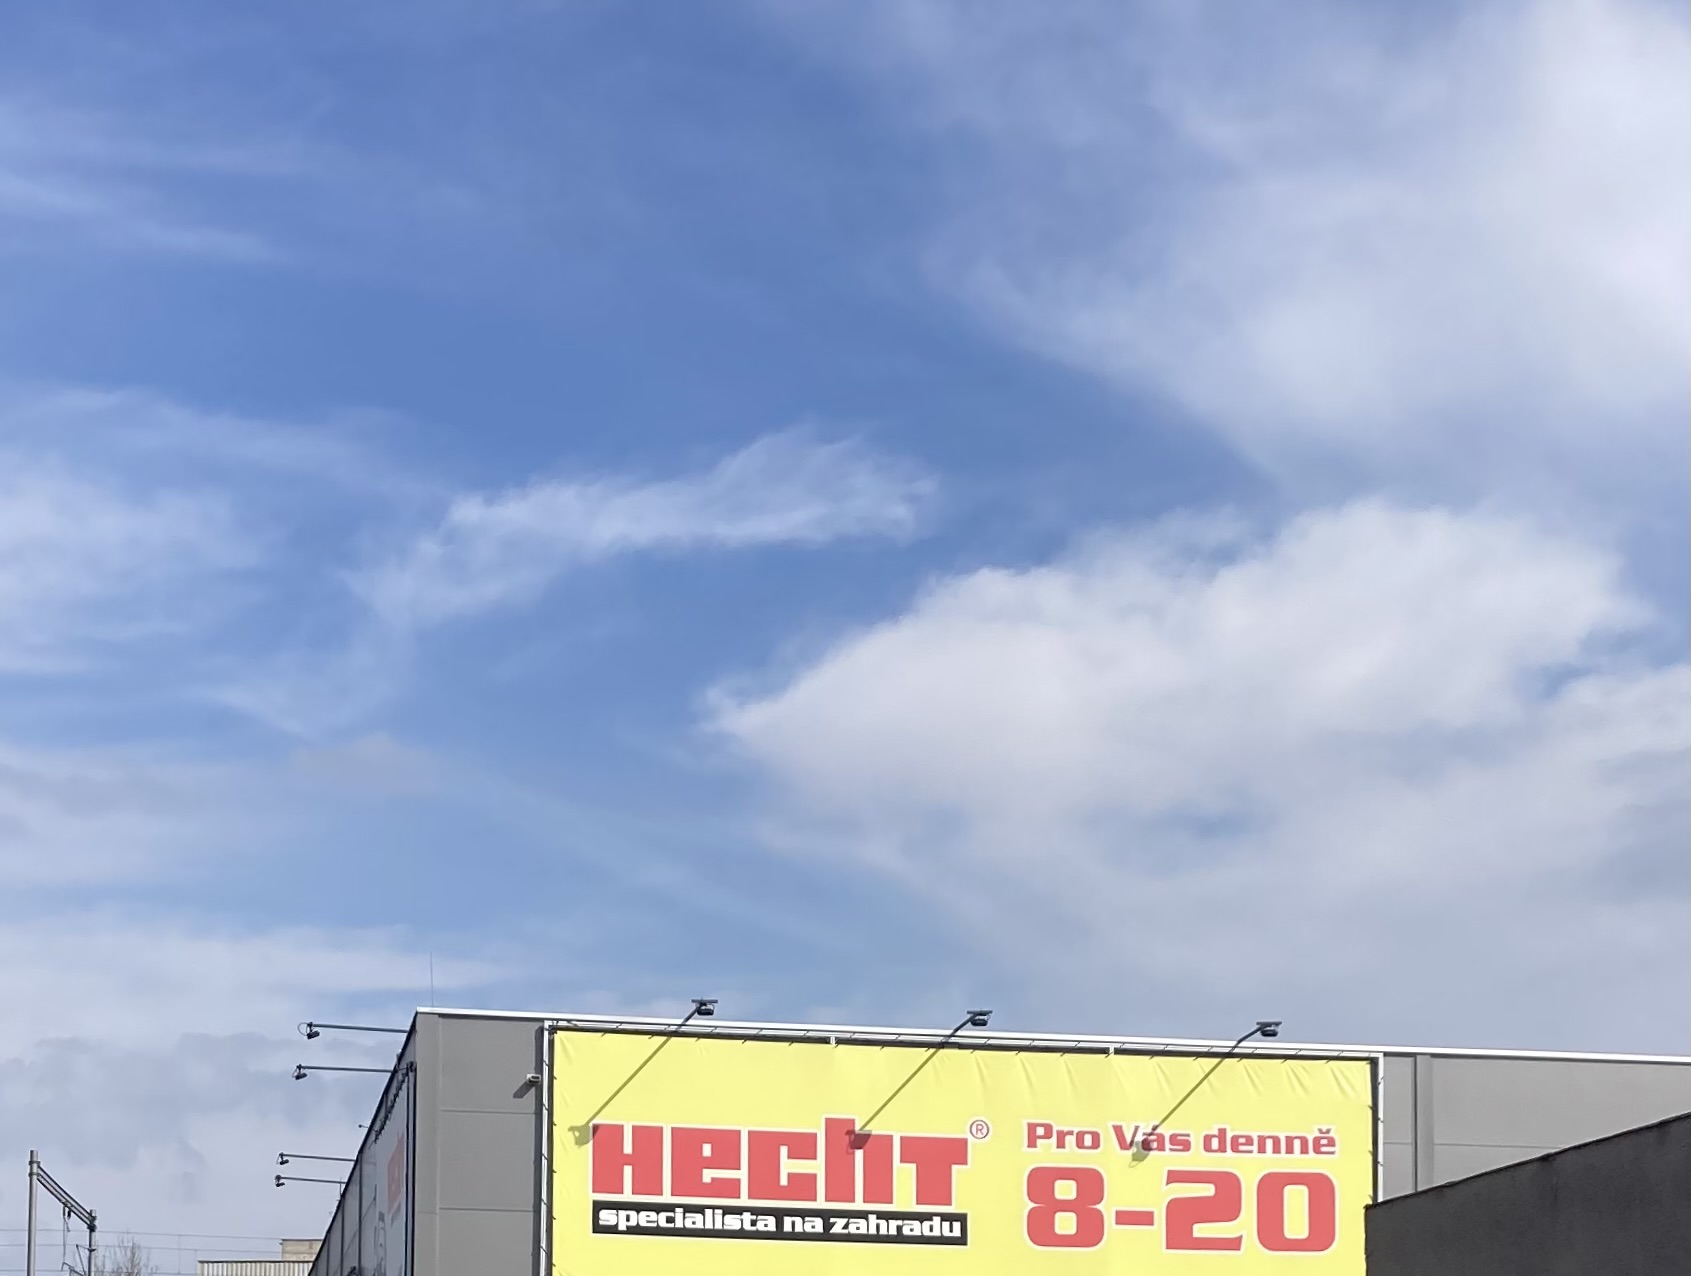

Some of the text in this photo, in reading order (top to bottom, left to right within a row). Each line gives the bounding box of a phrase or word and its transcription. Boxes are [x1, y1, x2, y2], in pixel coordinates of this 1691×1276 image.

[1027, 1122, 1336, 1155] Pro Vás denně
[598, 1207, 962, 1237] specialista na zahradu
[1027, 1166, 1336, 1252] 8-20
